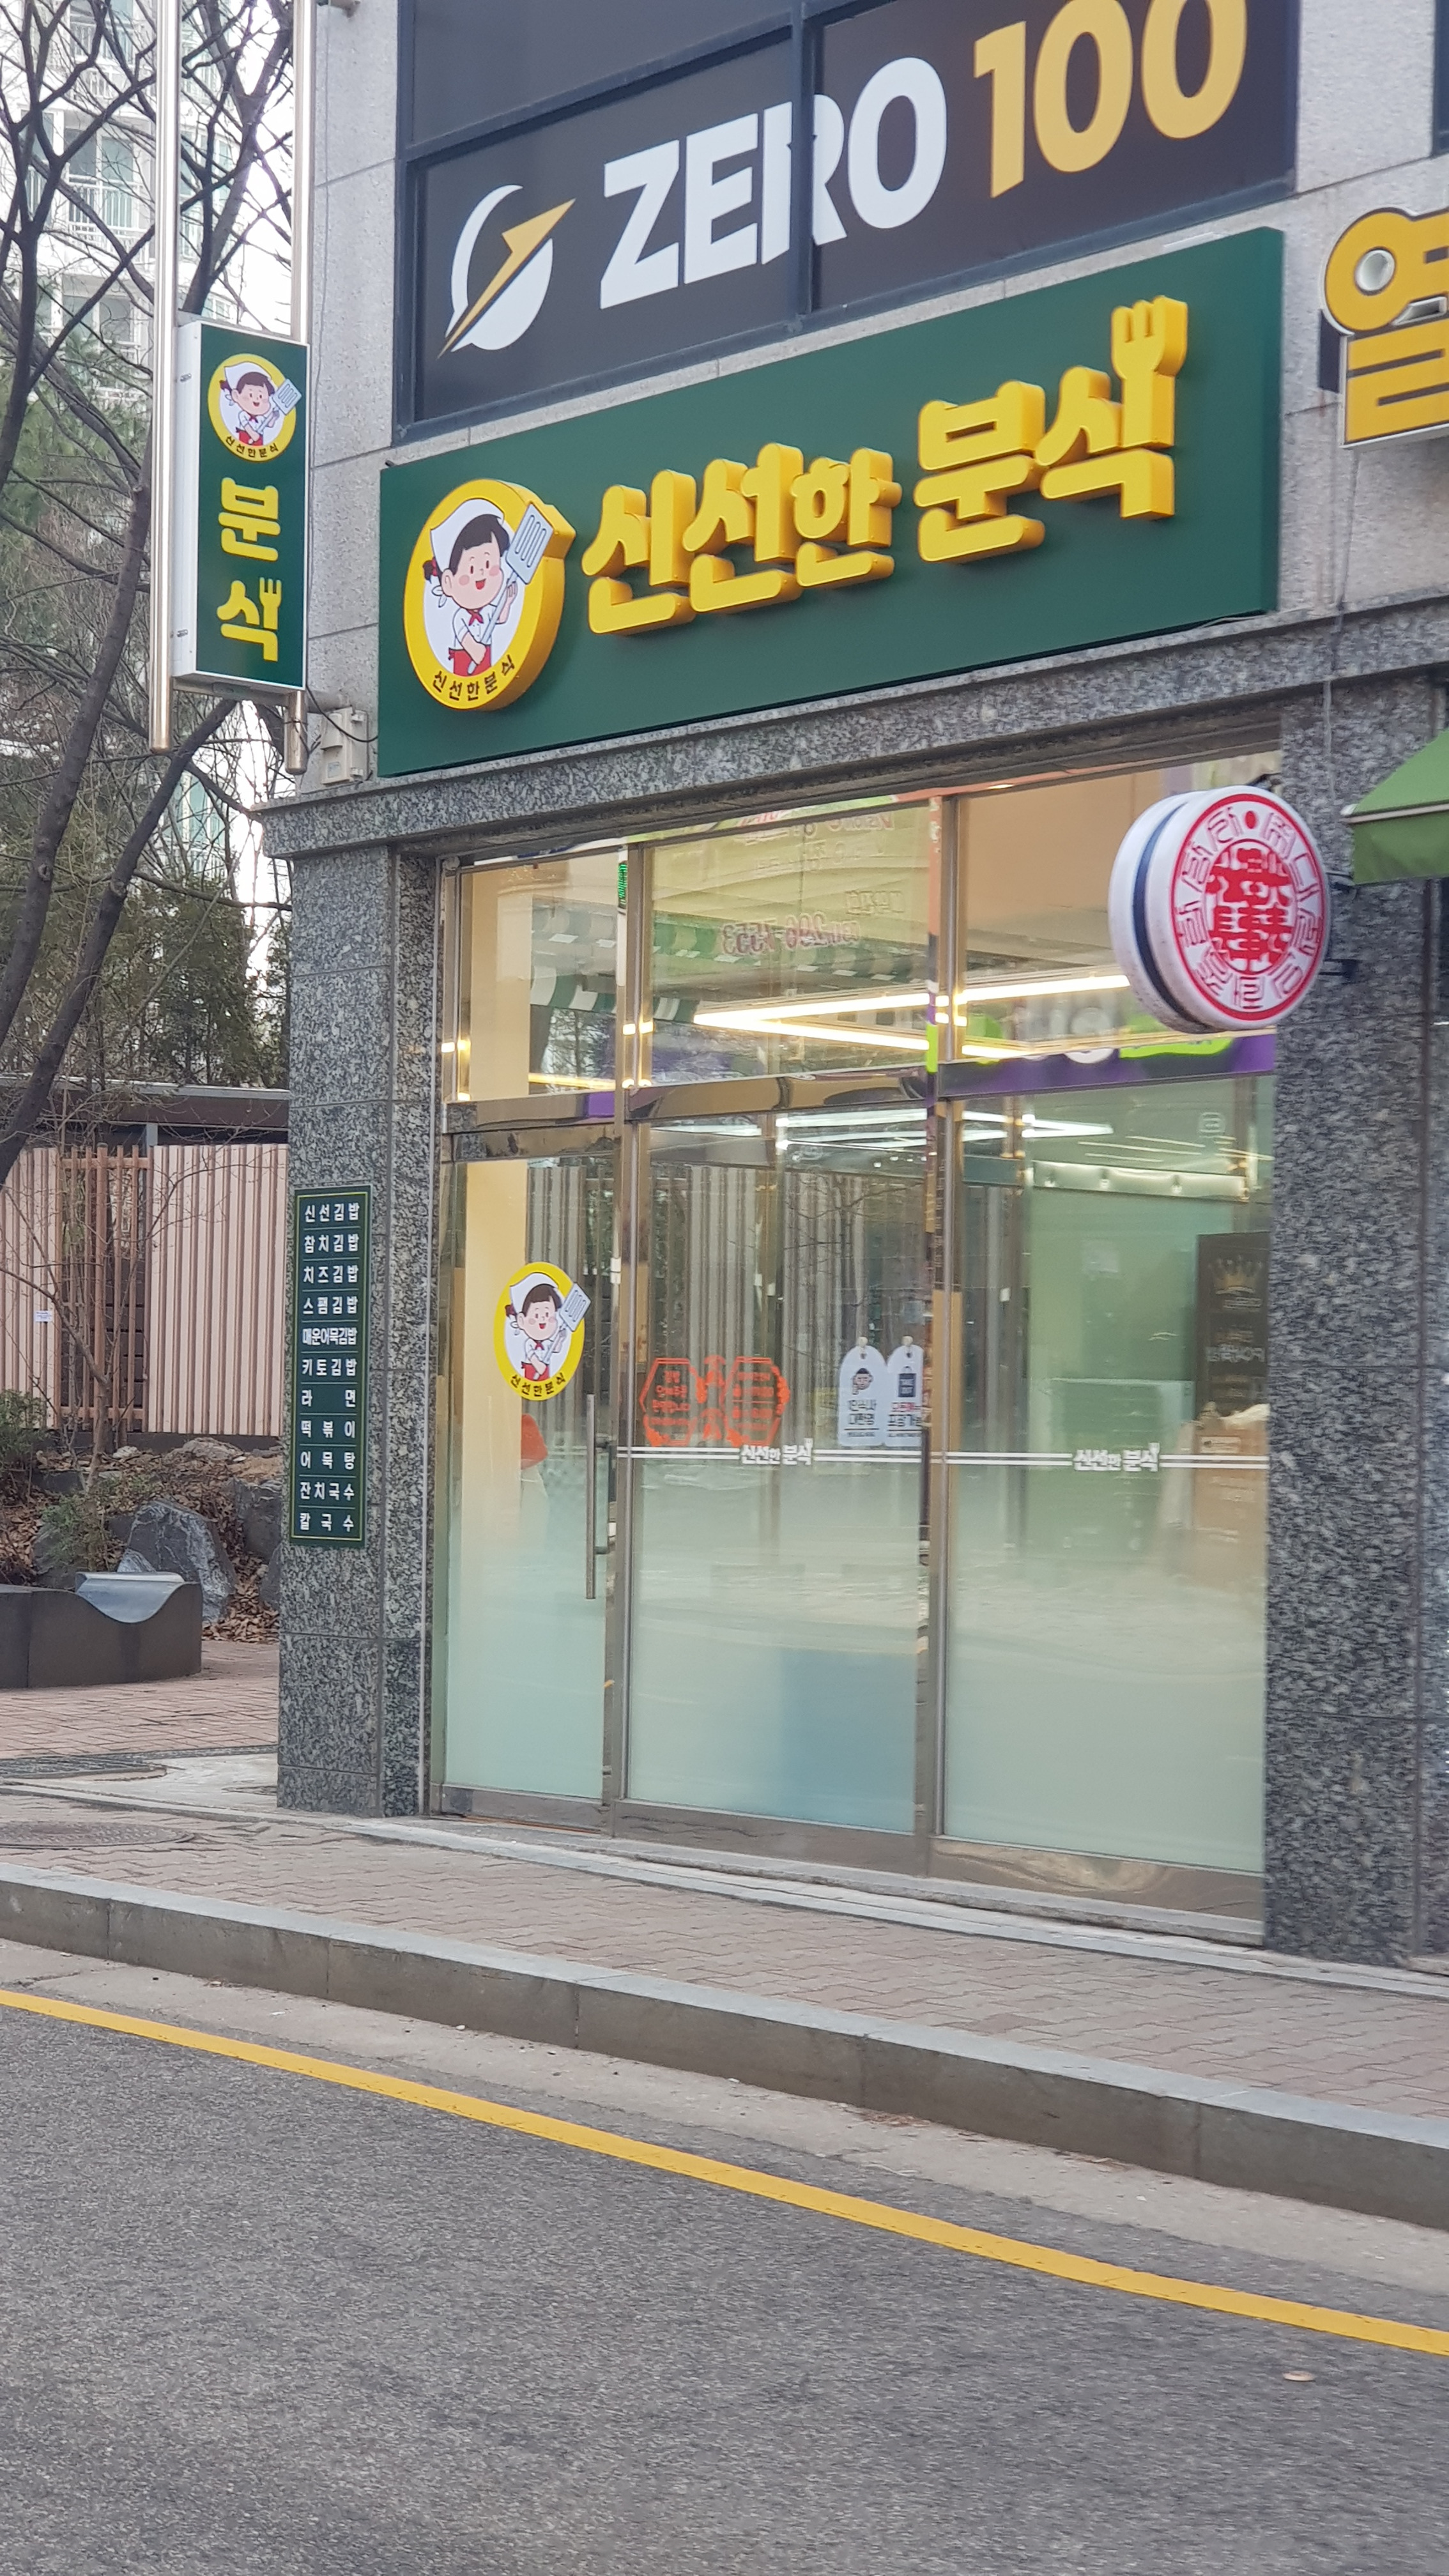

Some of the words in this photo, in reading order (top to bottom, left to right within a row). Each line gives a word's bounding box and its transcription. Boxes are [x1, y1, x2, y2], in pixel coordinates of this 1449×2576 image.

[601, 56, 947, 310] ZERO
[973, 0, 1247, 198] 100
[226, 436, 279, 457] 신선한분식
[581, 442, 902, 634] 신선한
[913, 295, 1188, 564] 분식
[216, 477, 282, 662] 분식
[433, 654, 515, 702] 신선한분식
[305, 1202, 360, 1222] 신선김밥
[304, 1234, 359, 1253] 참치김밥
[303, 1265, 358, 1284] 치즈김밥
[303, 1296, 358, 1315] 스팸김밥
[302, 1328, 357, 1346] 매운어묵김밥
[302, 1358, 356, 1376] 키토김밥
[510, 1372, 566, 1397] 신선한분식
[301, 1420, 355, 1438] 떡볶이
[300, 1452, 355, 1470] 어묵탕
[741, 1445, 781, 1464] 신선한
[782, 1438, 813, 1465] 분식
[1073, 1449, 1122, 1471] 신선한
[1123, 1442, 1160, 1472] 분식
[300, 1482, 355, 1501] 잔치국수
[300, 1513, 354, 1532] 칼국수
